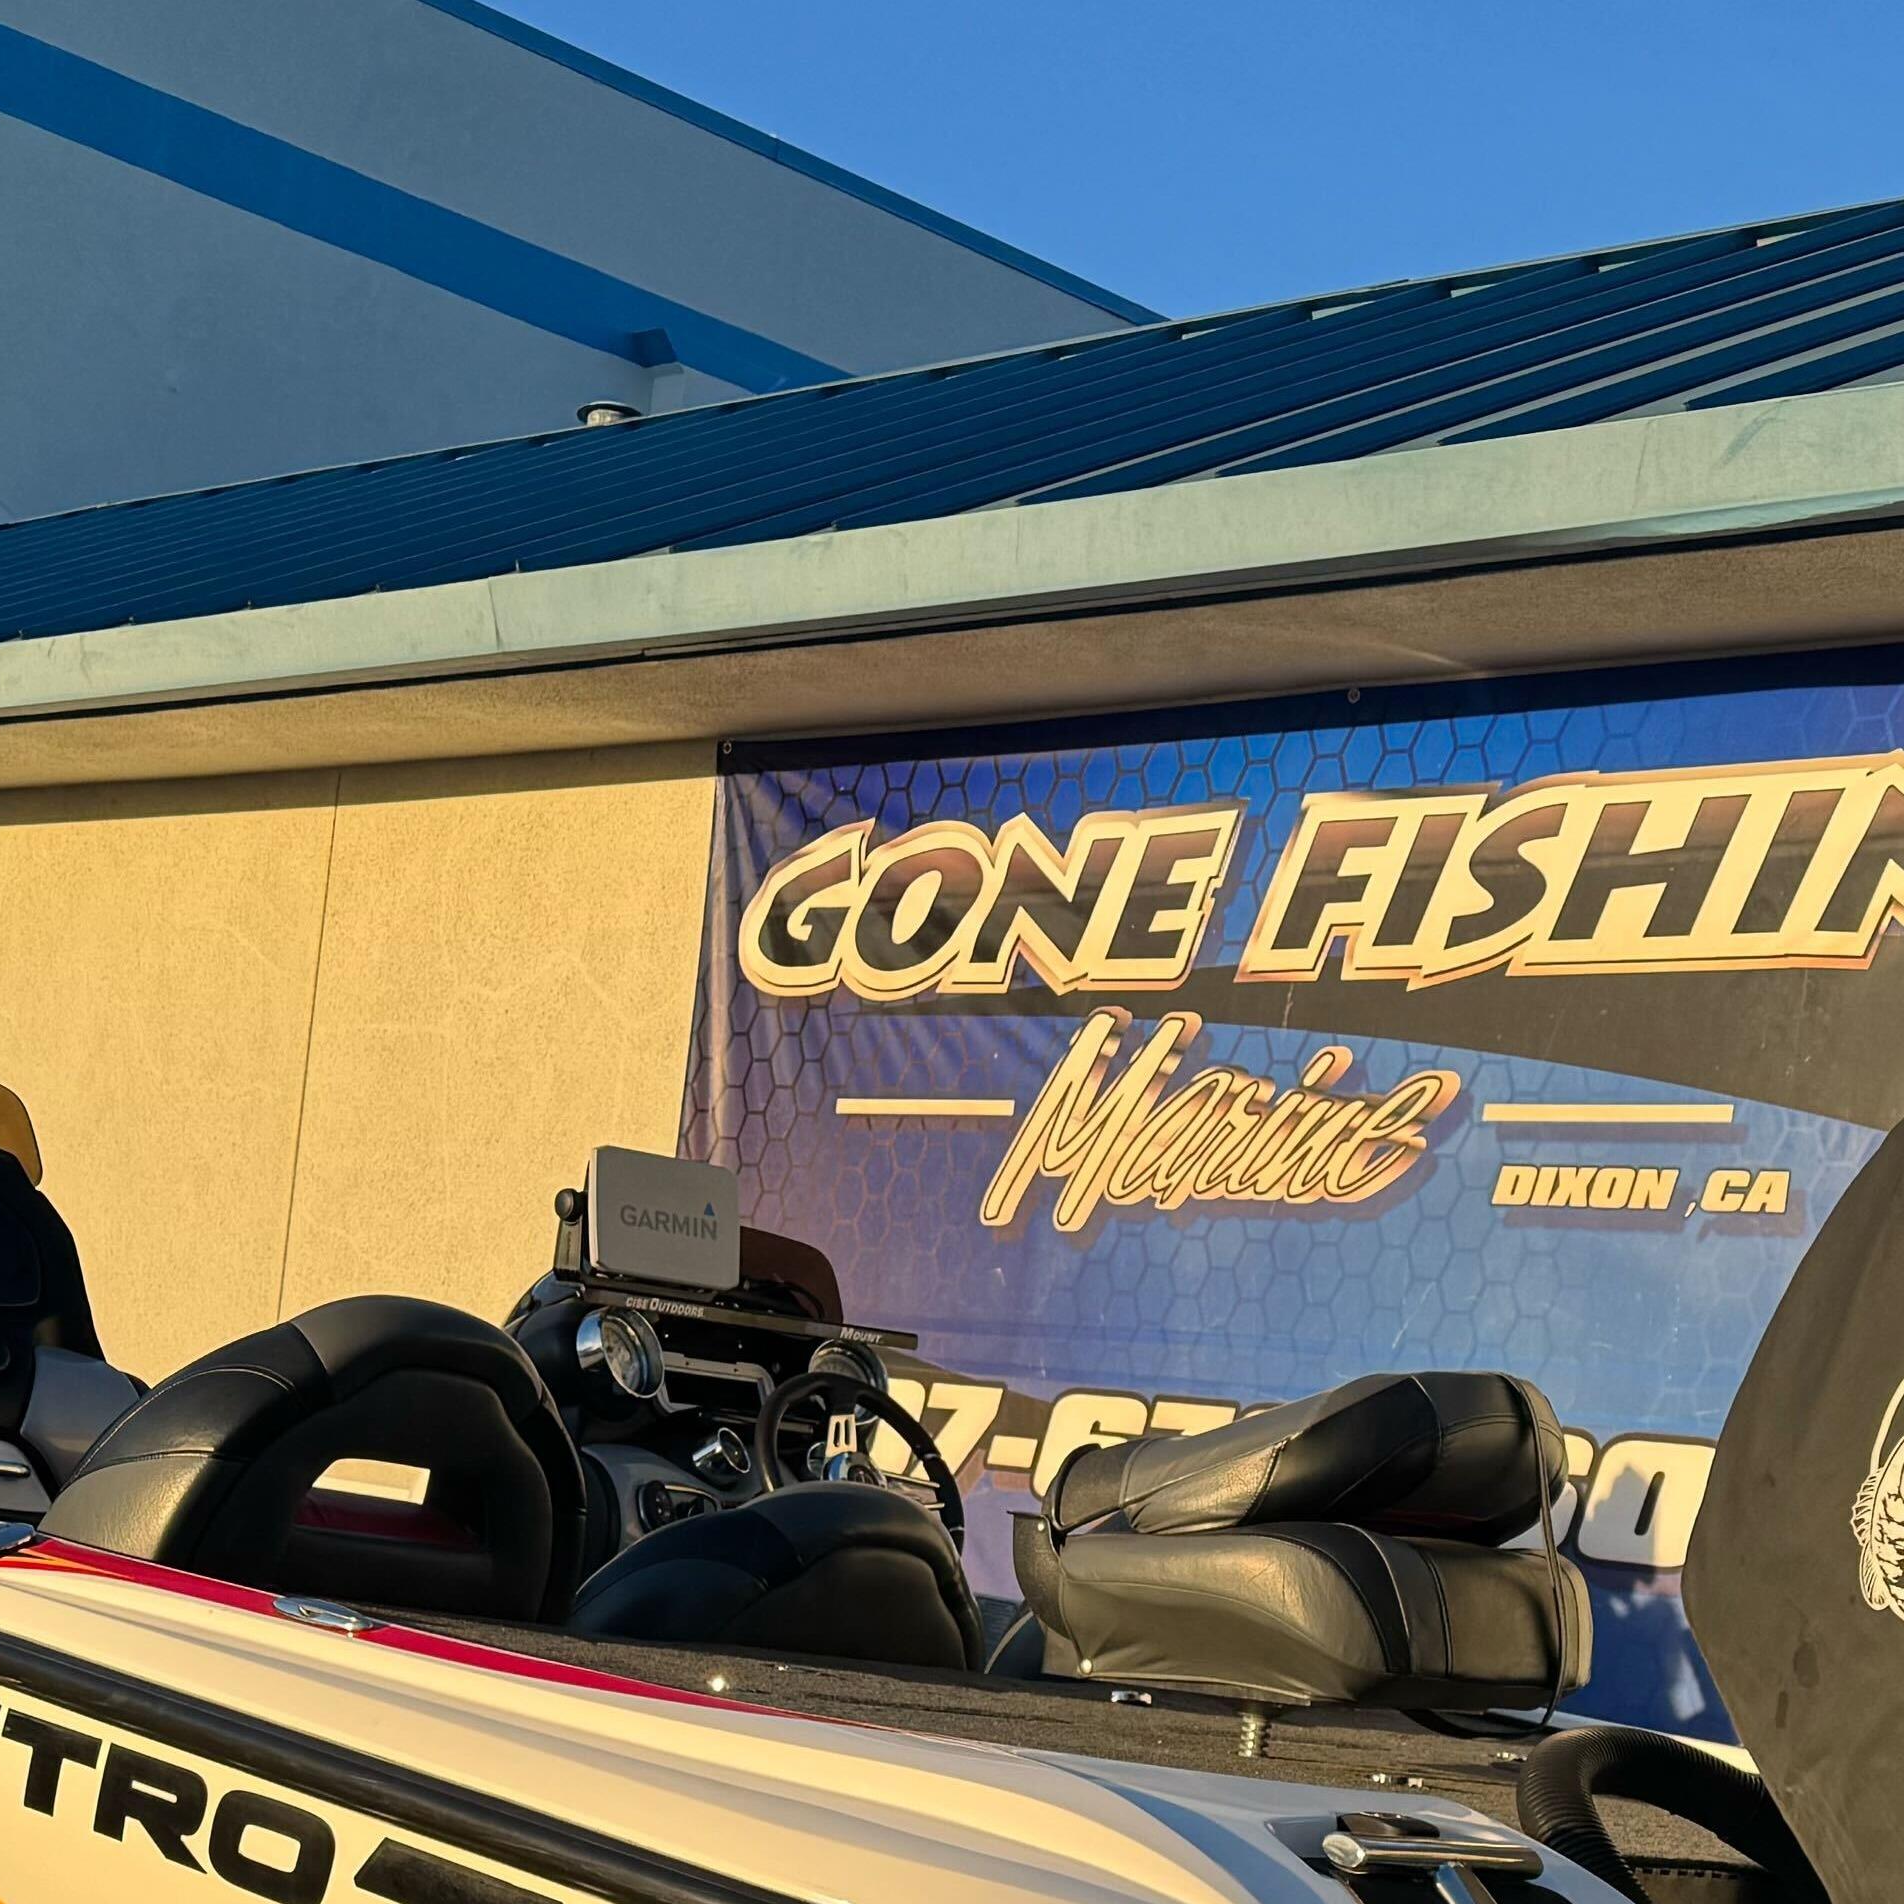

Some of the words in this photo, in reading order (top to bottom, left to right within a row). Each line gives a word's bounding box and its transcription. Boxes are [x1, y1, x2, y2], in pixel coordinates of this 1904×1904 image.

[740, 808, 1241, 998] GONE
[980, 1008, 1459, 1232] Marine
[619, 1202, 718, 1241] GARMIN
[1490, 1164, 1680, 1211] DIXON
